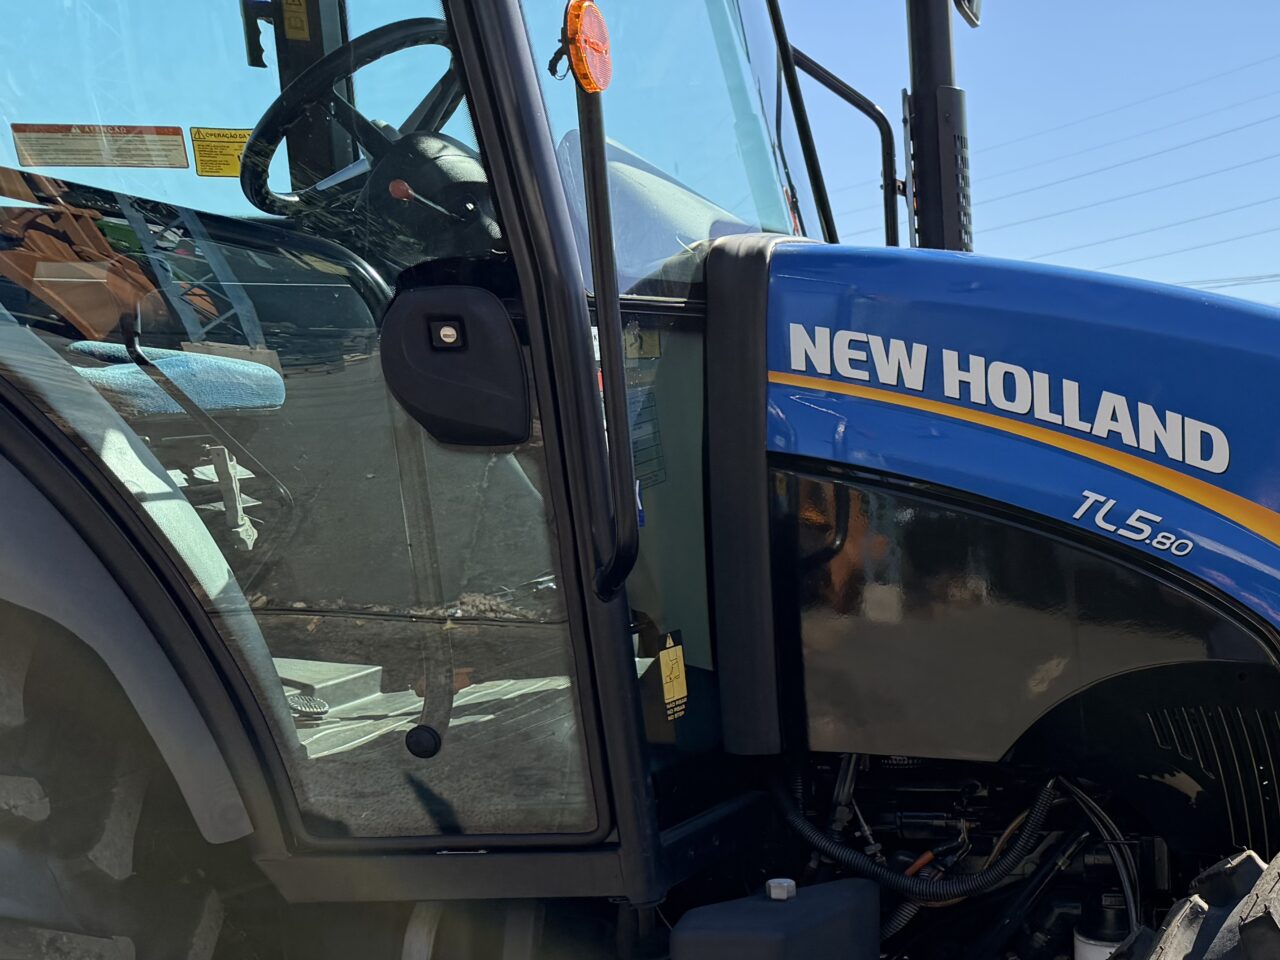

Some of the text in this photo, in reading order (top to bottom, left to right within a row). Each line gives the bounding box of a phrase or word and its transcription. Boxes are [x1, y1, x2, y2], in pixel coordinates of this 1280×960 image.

[789, 322, 1231, 475] NEW HOLLAND
[1071, 489, 1194, 557] TL5.80
